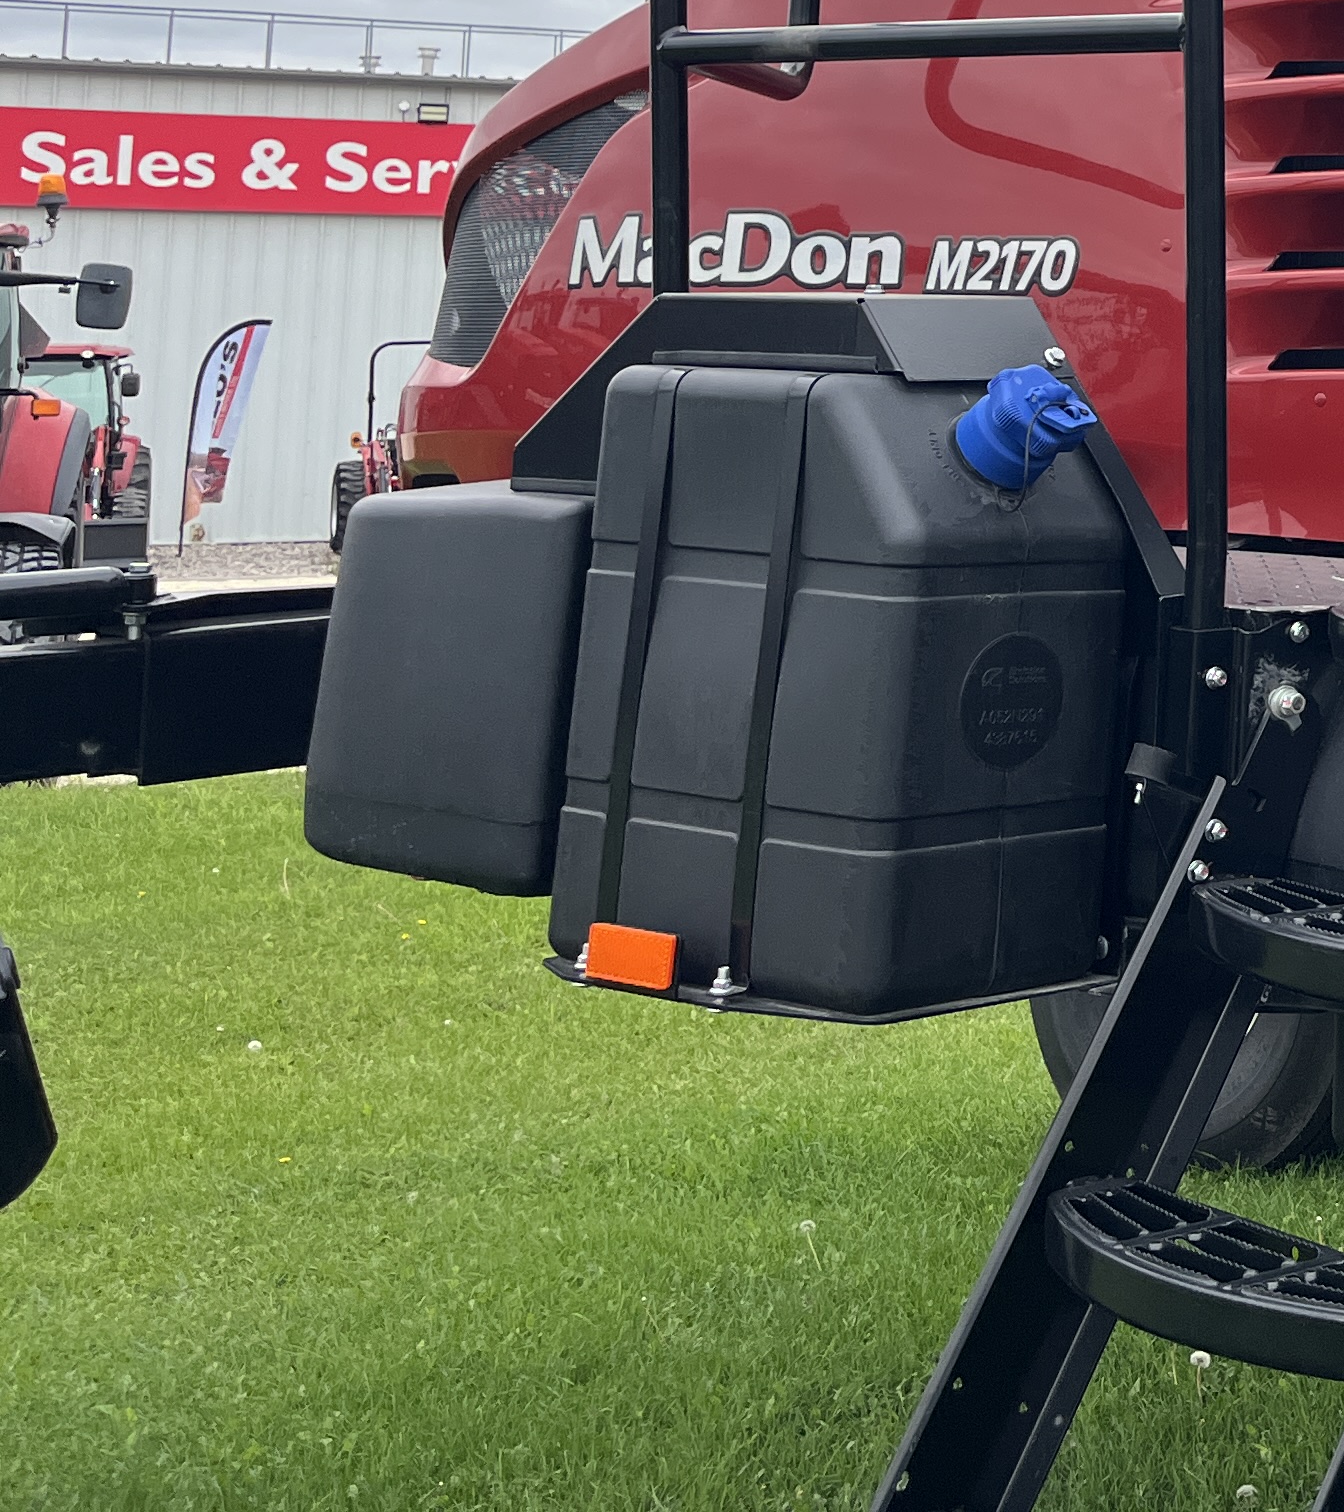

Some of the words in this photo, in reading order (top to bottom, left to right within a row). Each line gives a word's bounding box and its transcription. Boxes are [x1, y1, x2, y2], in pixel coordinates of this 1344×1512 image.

[20, 130, 215, 189] Sales
[241, 138, 299, 191] &
[325, 141, 460, 194] Ser
[926, 237, 1078, 294] M2170
